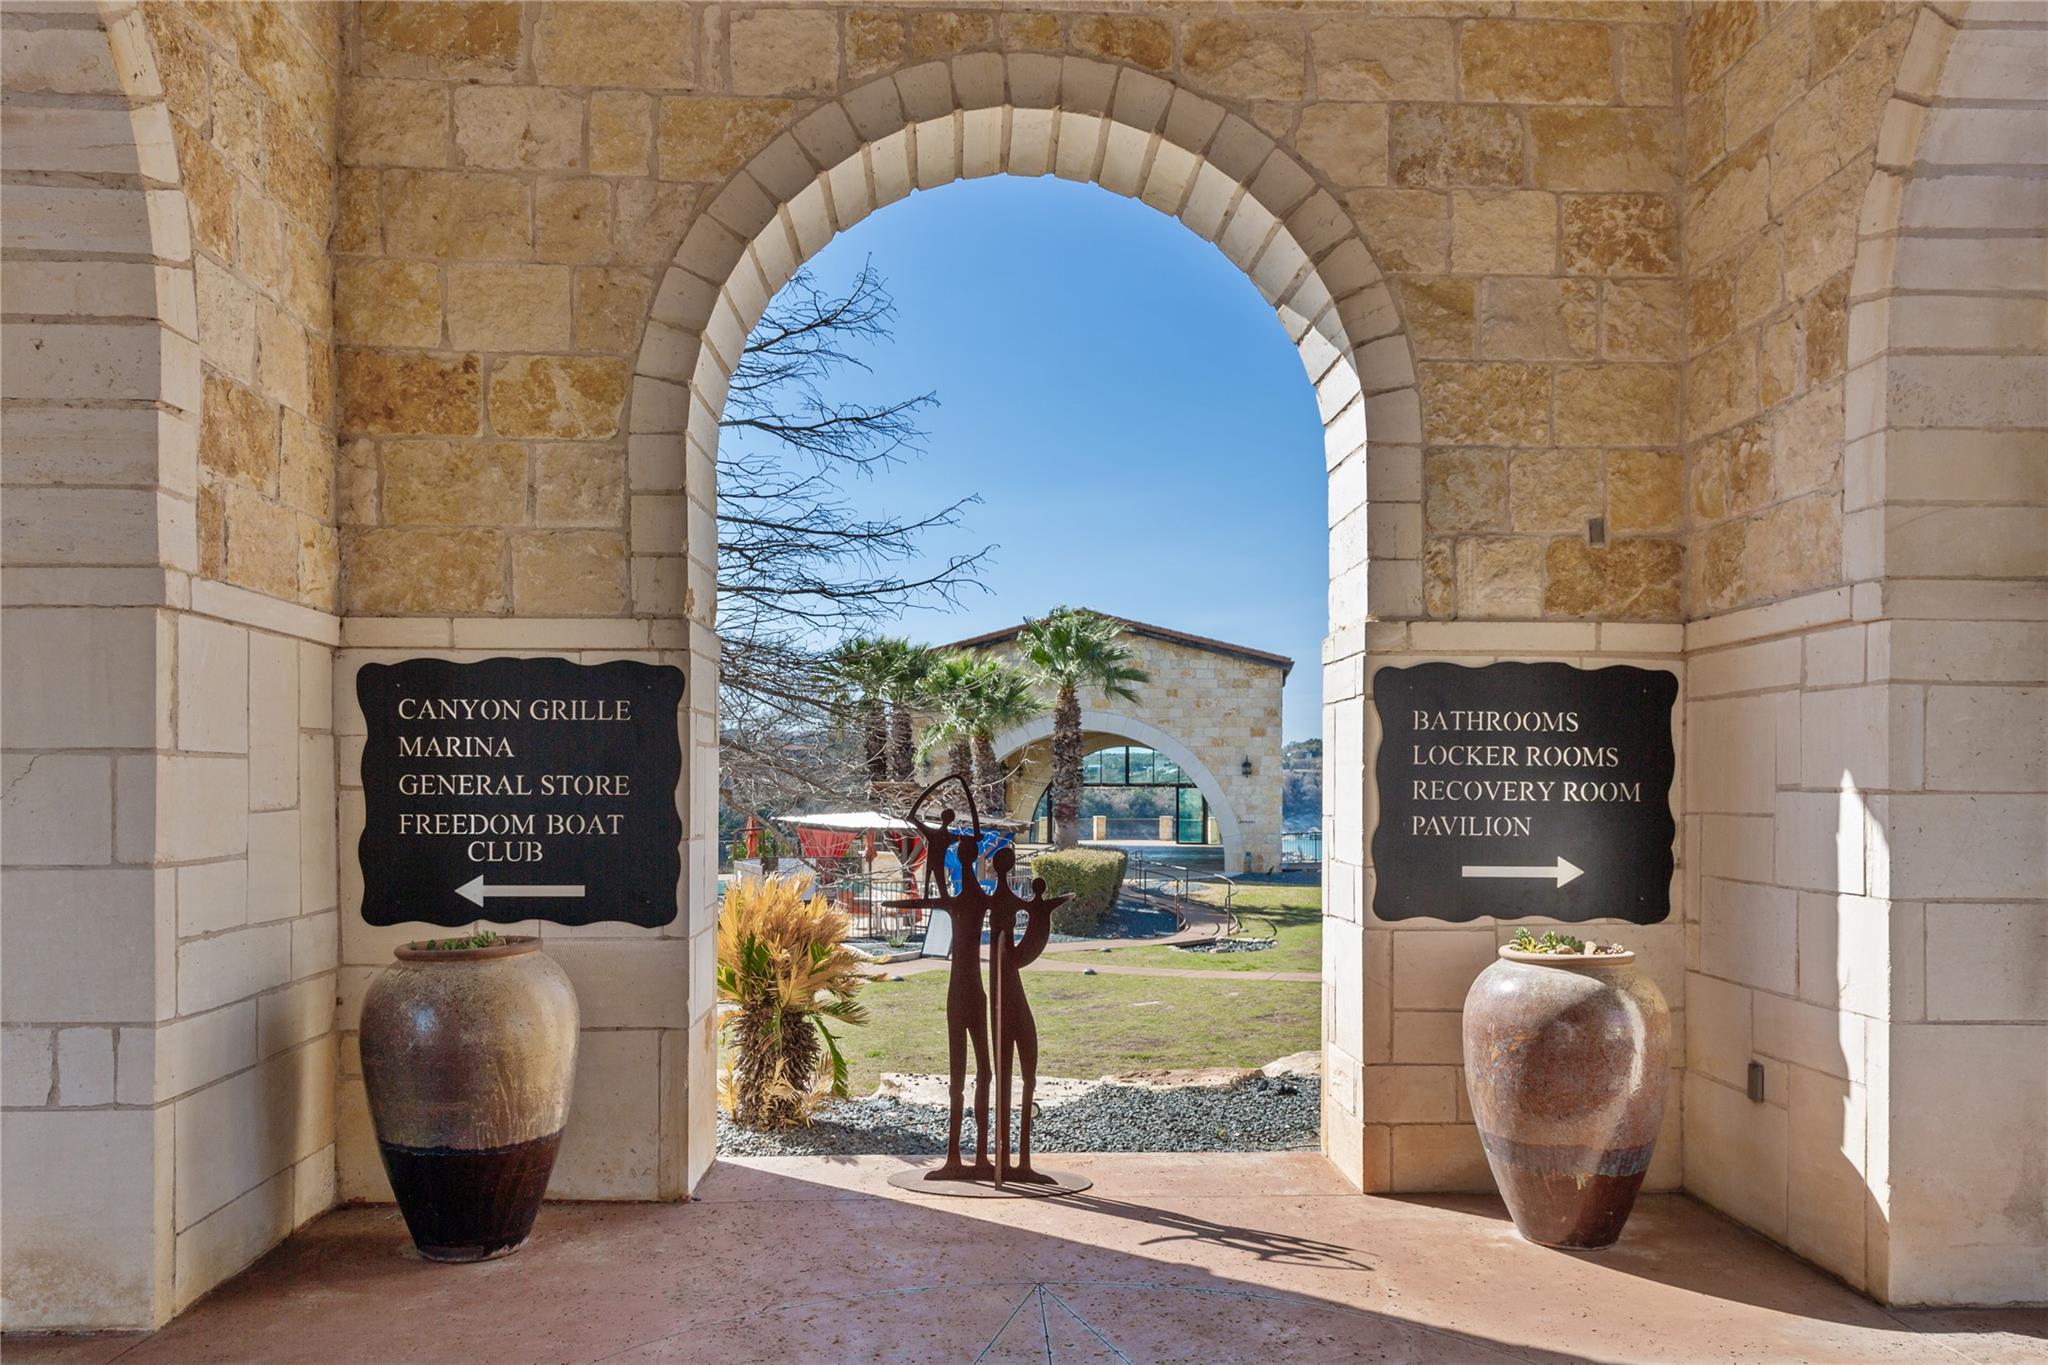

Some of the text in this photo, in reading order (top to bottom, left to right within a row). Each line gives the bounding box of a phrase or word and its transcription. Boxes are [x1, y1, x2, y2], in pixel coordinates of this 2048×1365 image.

[398, 698, 632, 721] CANYON GRILLE
[1413, 710, 1580, 733] BATHROOMS
[398, 736, 515, 758] MARINA
[1413, 745, 1620, 767] LOCKER ROOMS
[398, 774, 631, 796] GENERAL STORE
[1413, 780, 1642, 803] RECOVERY ROOM
[398, 813, 624, 835] FREEDOM BOAT
[1412, 815, 1532, 837] PAVILION
[467, 840, 544, 862] CLUB
